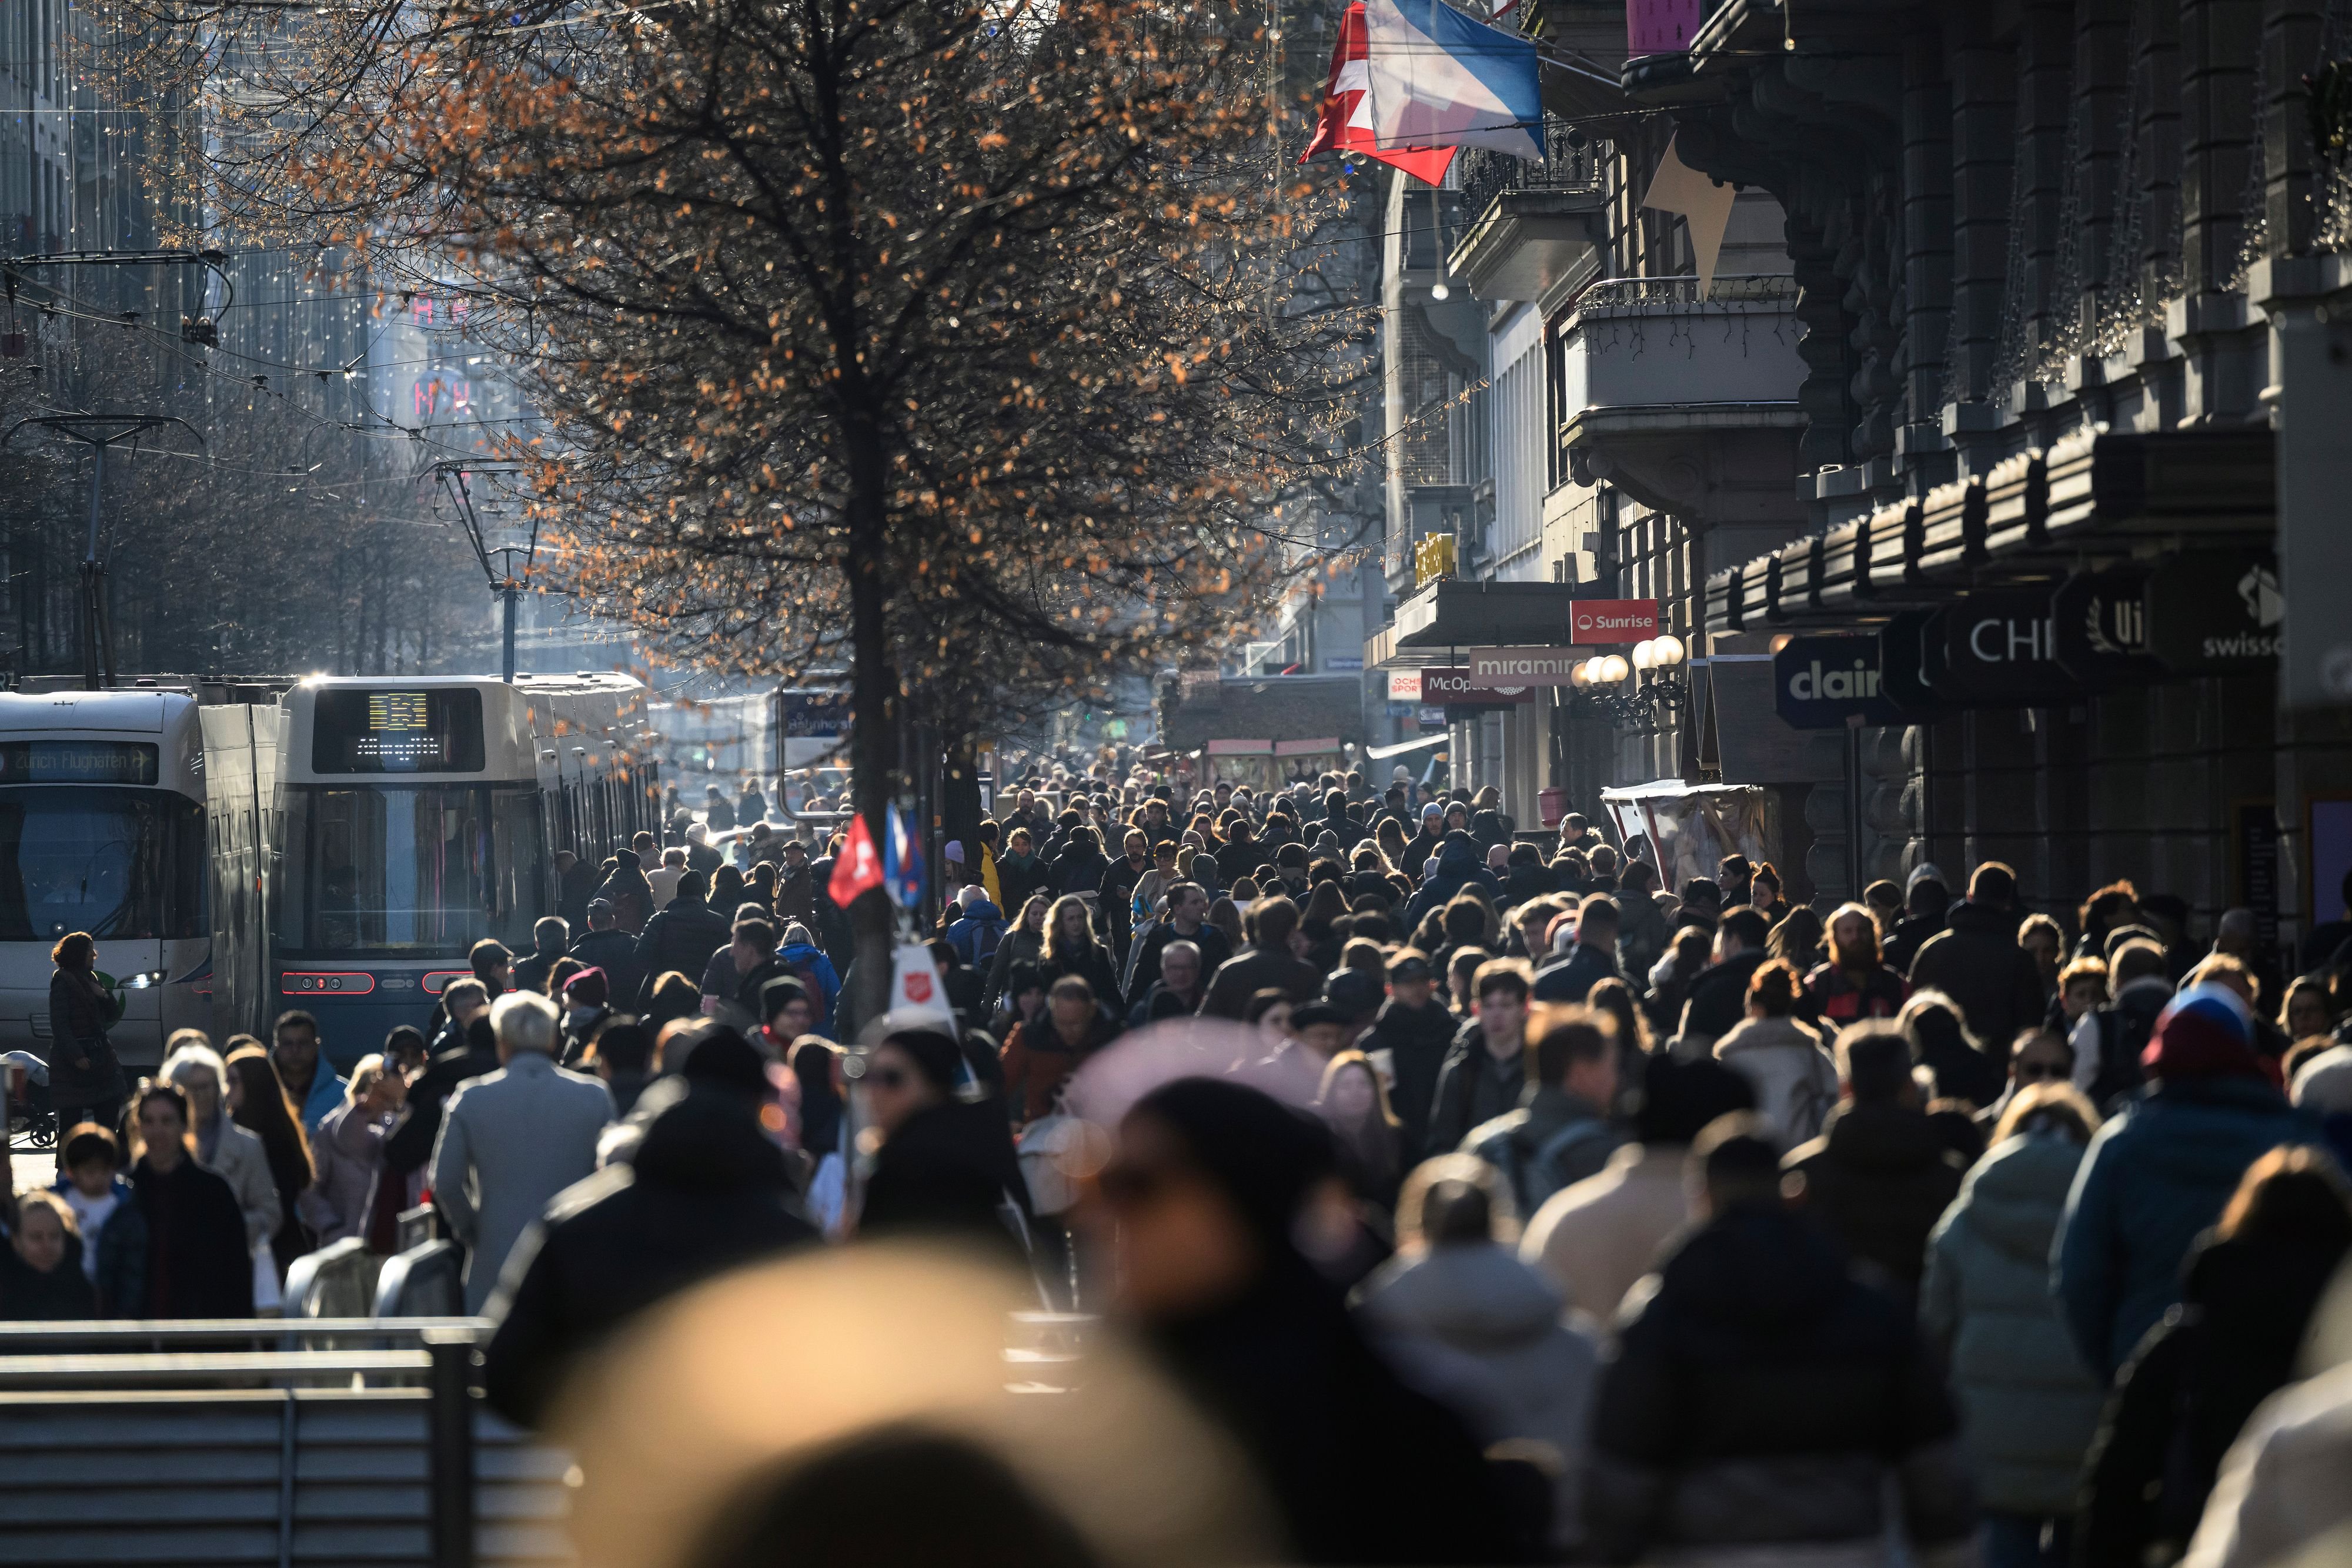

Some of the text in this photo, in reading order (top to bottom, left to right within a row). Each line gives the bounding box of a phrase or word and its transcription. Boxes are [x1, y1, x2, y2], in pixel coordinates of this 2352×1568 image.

[1596, 614, 1653, 629] Sunrise
[1429, 677, 1489, 693] McOp
[62, 750, 126, 773] Flughafen
